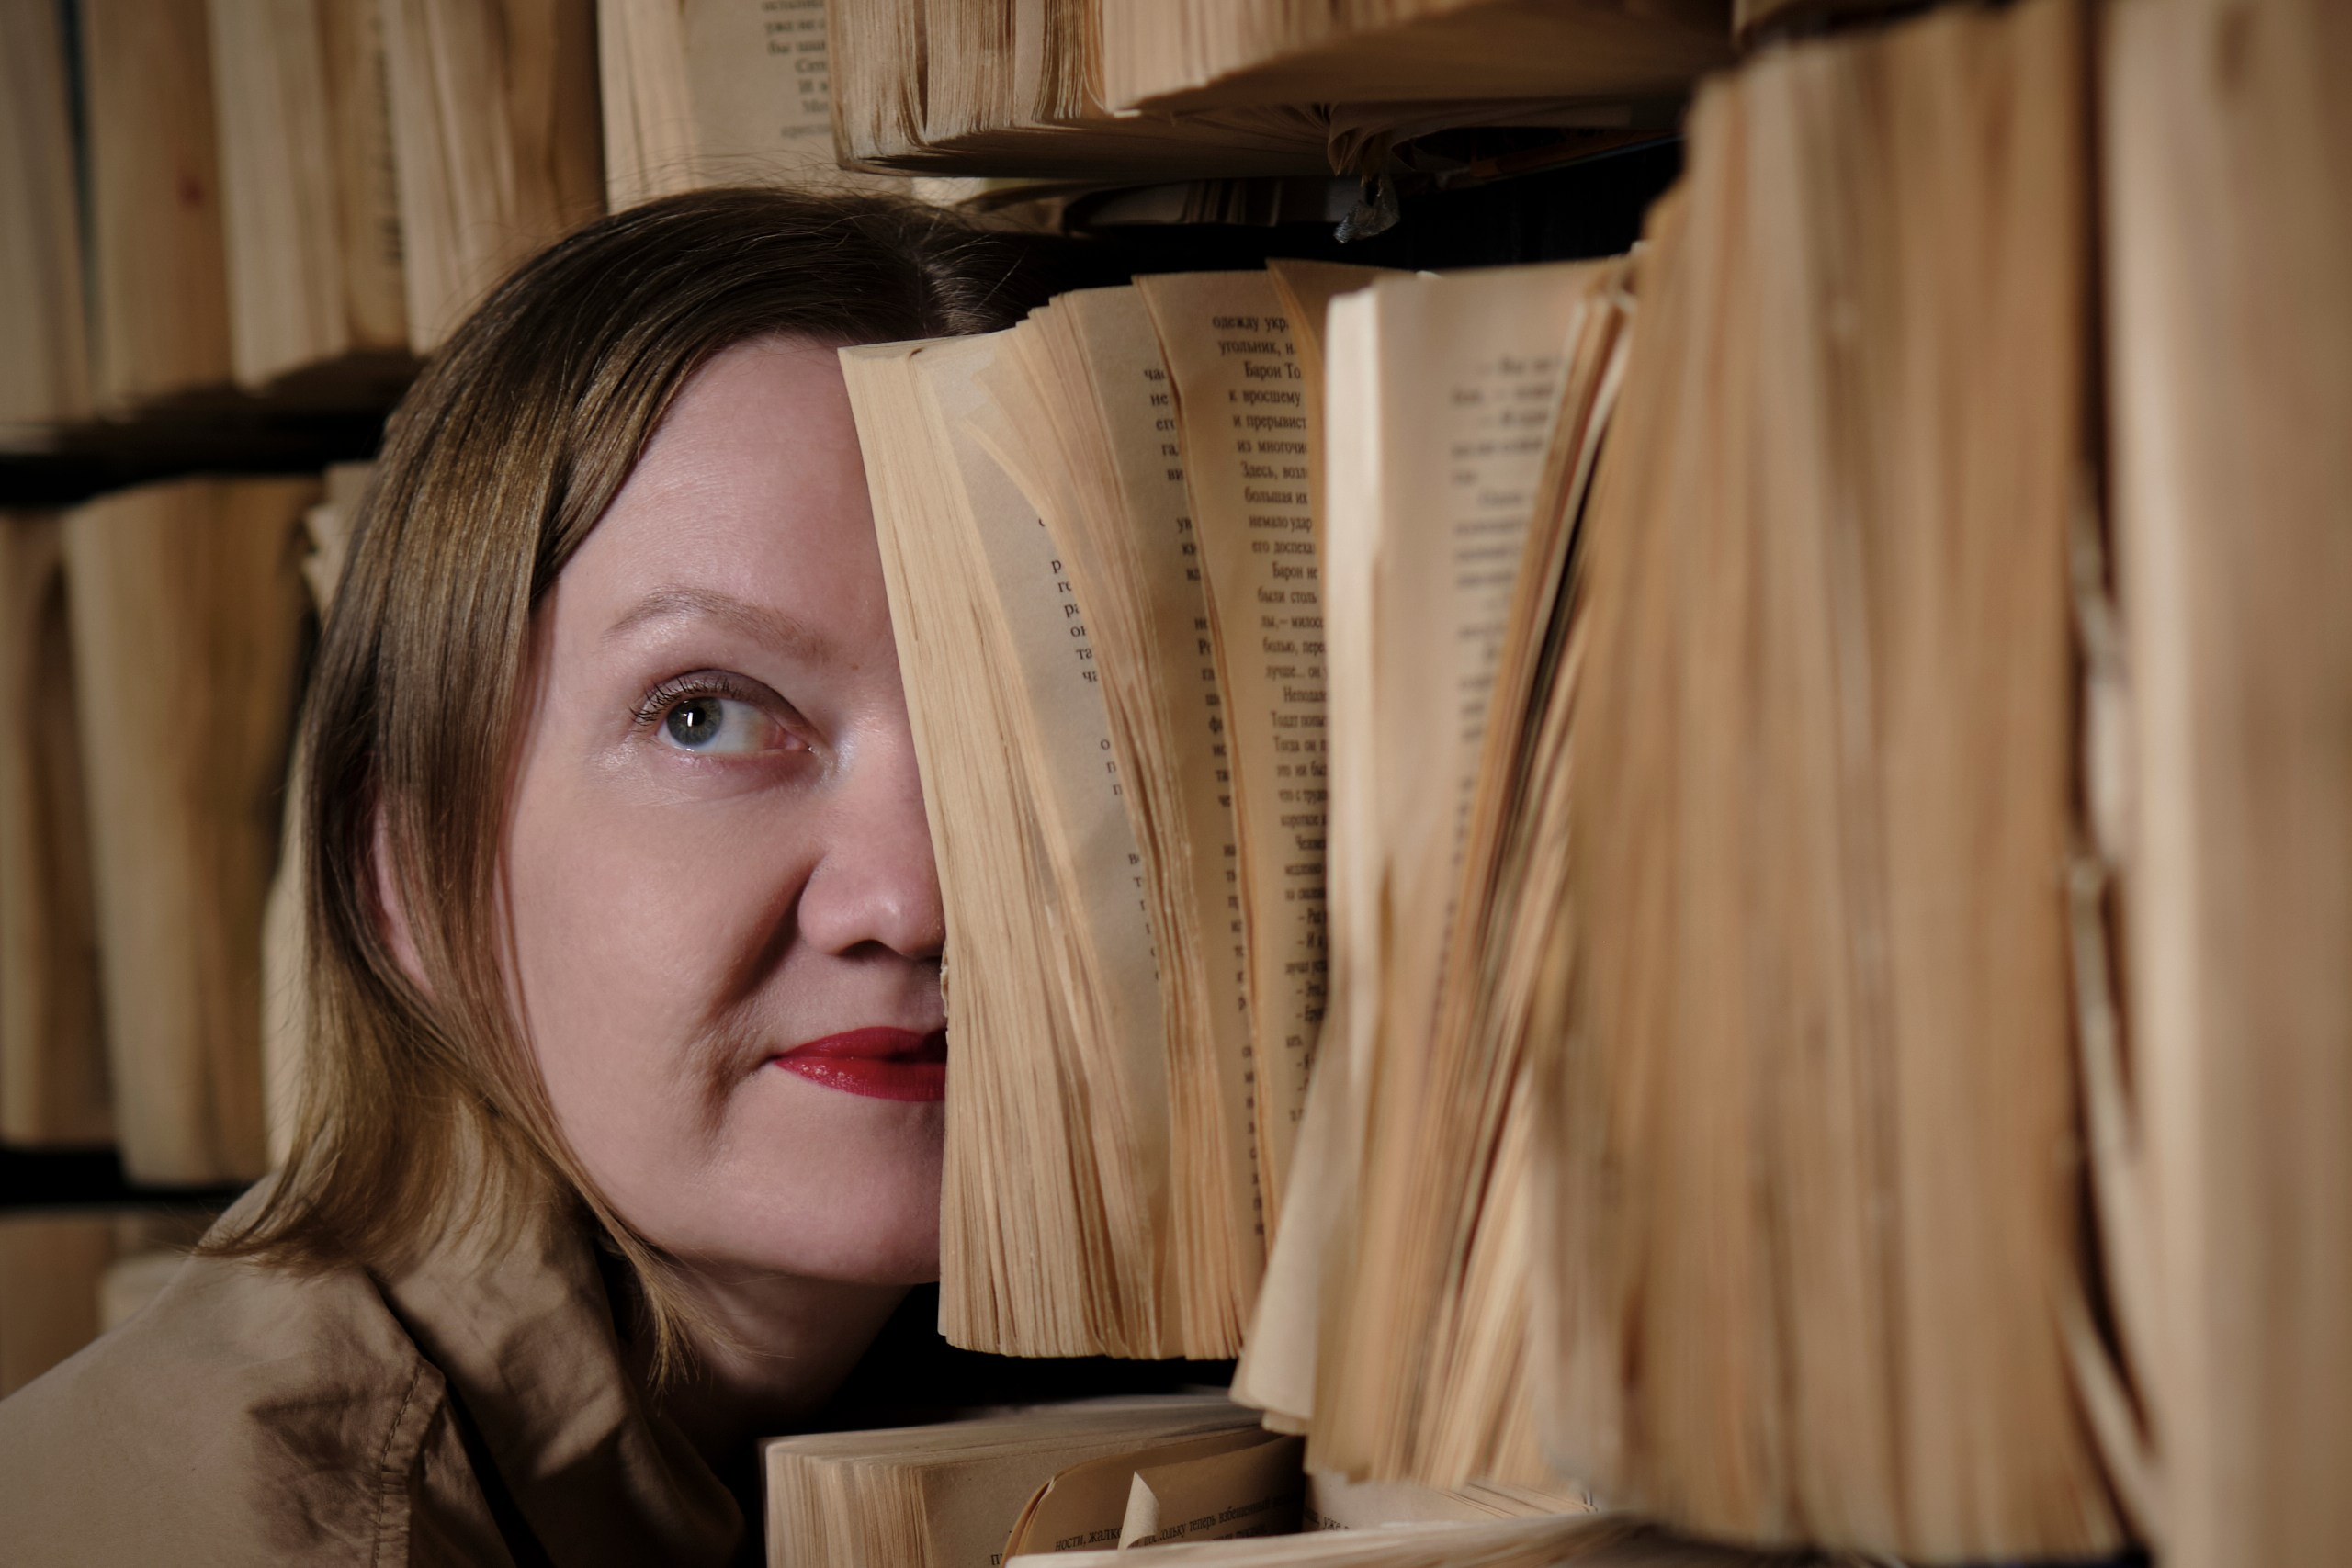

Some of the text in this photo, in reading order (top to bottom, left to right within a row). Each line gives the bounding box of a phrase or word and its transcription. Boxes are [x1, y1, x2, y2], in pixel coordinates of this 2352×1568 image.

[1212, 316, 1289, 332] одежду укр
[1217, 340, 1281, 356] угольник,
[1244, 360, 1283, 380] Барон
[1242, 389, 1301, 407] вросшему
[1236, 440, 1307, 455] из многочи
[1240, 460, 1307, 479] Здесь, возл
[1244, 485, 1293, 504] большая
[1249, 515, 1288, 529] немало
[1273, 540, 1316, 555] доспеха
[1272, 560, 1304, 582] Барон
[1055, 1534, 1087, 1552] ности,
[1189, 1515, 1216, 1532] теперь
